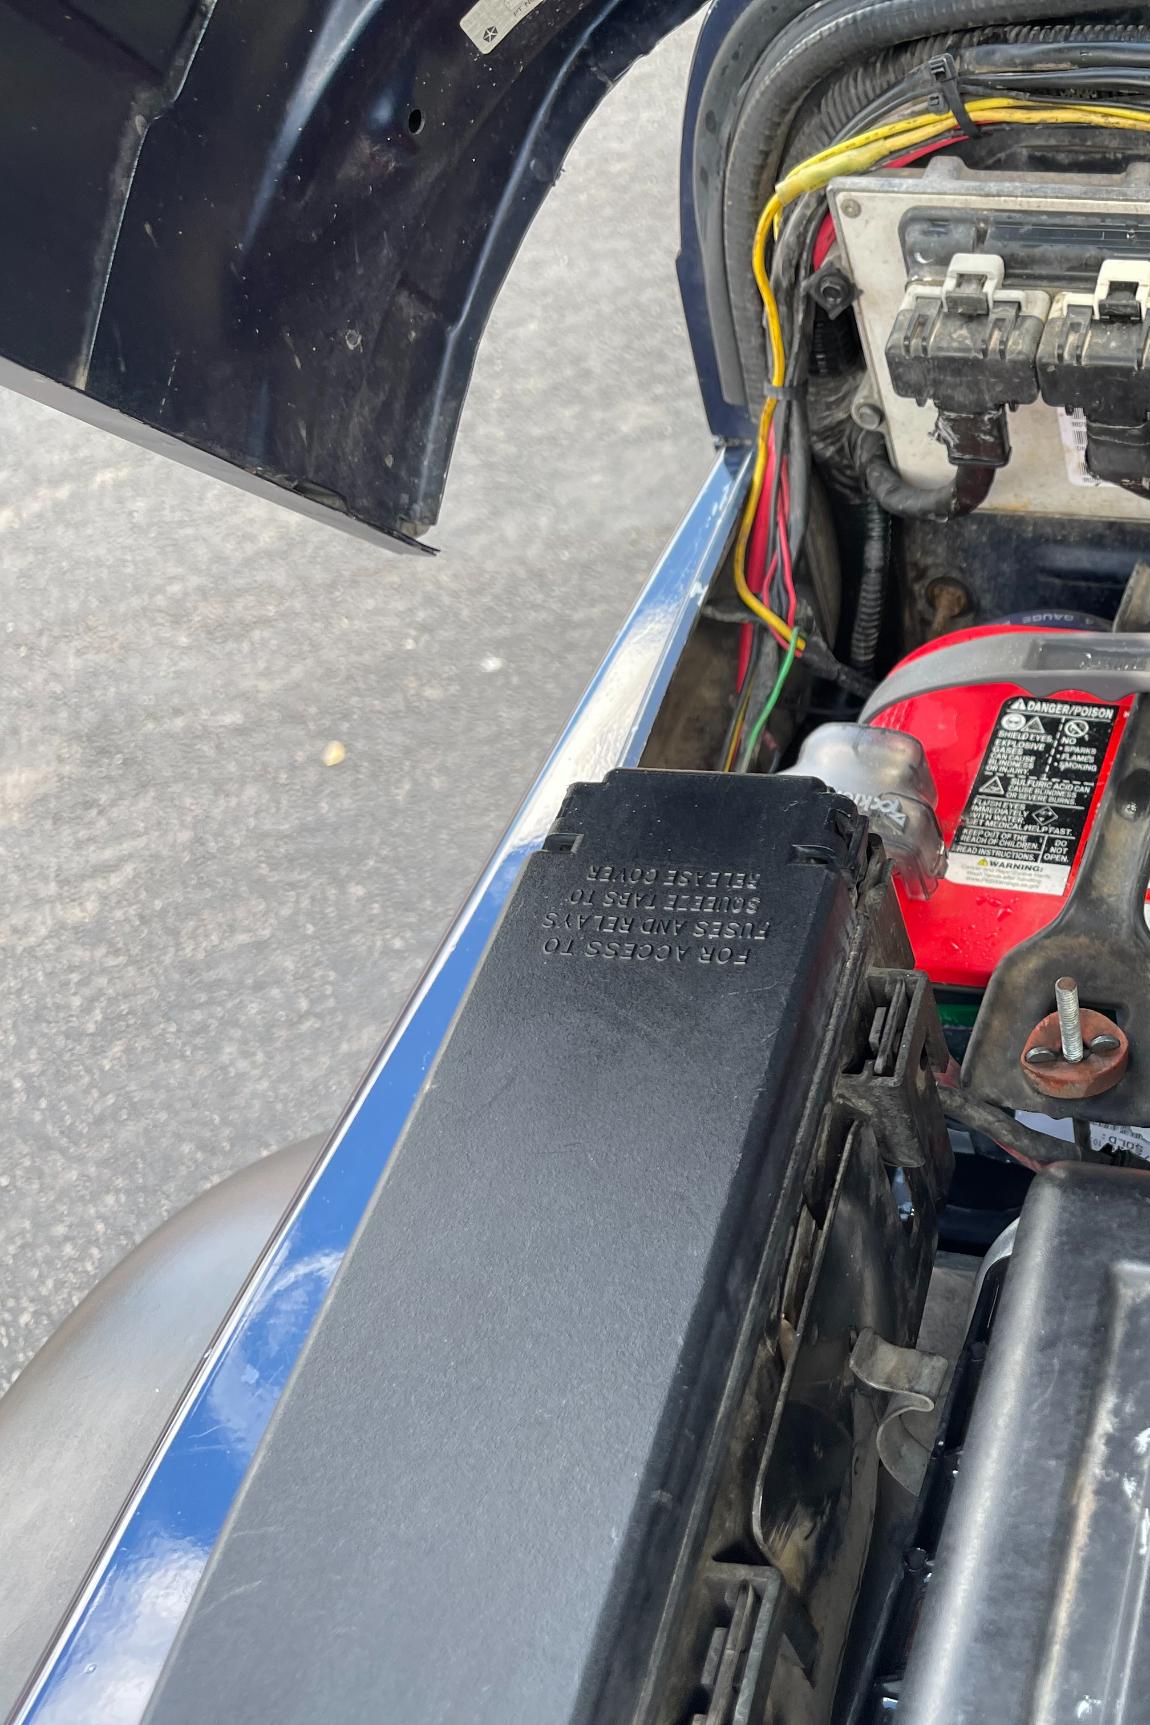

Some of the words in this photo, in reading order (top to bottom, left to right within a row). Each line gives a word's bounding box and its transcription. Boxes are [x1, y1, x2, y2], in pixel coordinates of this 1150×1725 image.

[1026, 700, 1115, 720] DANGER/POISON
[997, 729, 1030, 741] SHIELD
[1060, 736, 1077, 745] NO
[992, 746, 1024, 756] GASES
[994, 738, 1046, 752] EXPLOSIVE
[1064, 745, 1097, 756] SPARKS
[988, 759, 1035, 770] BLINDNESS
[990, 752, 1008, 761] CAN
[1009, 754, 1036, 763] CAUSE
[1061, 752, 1096, 764] FLAMES
[1058, 761, 1098, 773] SMOKING
[1007, 784, 1033, 793] CAUSE
[1033, 787, 1077, 799] BLINDNESS
[1010, 778, 1053, 789] SULFURIC
[1053, 782, 1075, 792] ACID
[1073, 785, 1091, 794] CAN
[1005, 791, 1018, 799] OR
[1018, 792, 1049, 803] SEVERE
[970, 804, 1030, 818] IMMEDIATELY
[972, 798, 1002, 808] FLUSH
[1003, 801, 1027, 811] EYES
[969, 811, 992, 820] WITH
[986, 820, 1023, 832] MEDICAL
[1023, 824, 1049, 834] HELP
[960, 833, 987, 844] REACH
[986, 836, 998, 846] OF
[962, 828, 985, 838] KEEP
[984, 830, 1001, 839] OUT
[1001, 832, 1013, 840] OF
[1013, 833, 1030, 843] THE
[956, 845, 978, 855] READ
[1054, 839, 1068, 848] DO
[1049, 846, 1069, 856] NOT
[586, 865, 658, 883] COVER
[989, 861, 1044, 873] WARNING:
[663, 869, 761, 889] RELEASE
[570, 888, 595, 906] TO
[602, 891, 658, 909] TABS
[663, 894, 761, 914] SQUEEZE
[541, 912, 633, 934] RELAYS
[641, 918, 687, 936] AND
[693, 921, 770, 940] FUSES
[543, 937, 573, 956] TO
[584, 941, 692, 962] ACCESS
[698, 947, 751, 965] FOR
